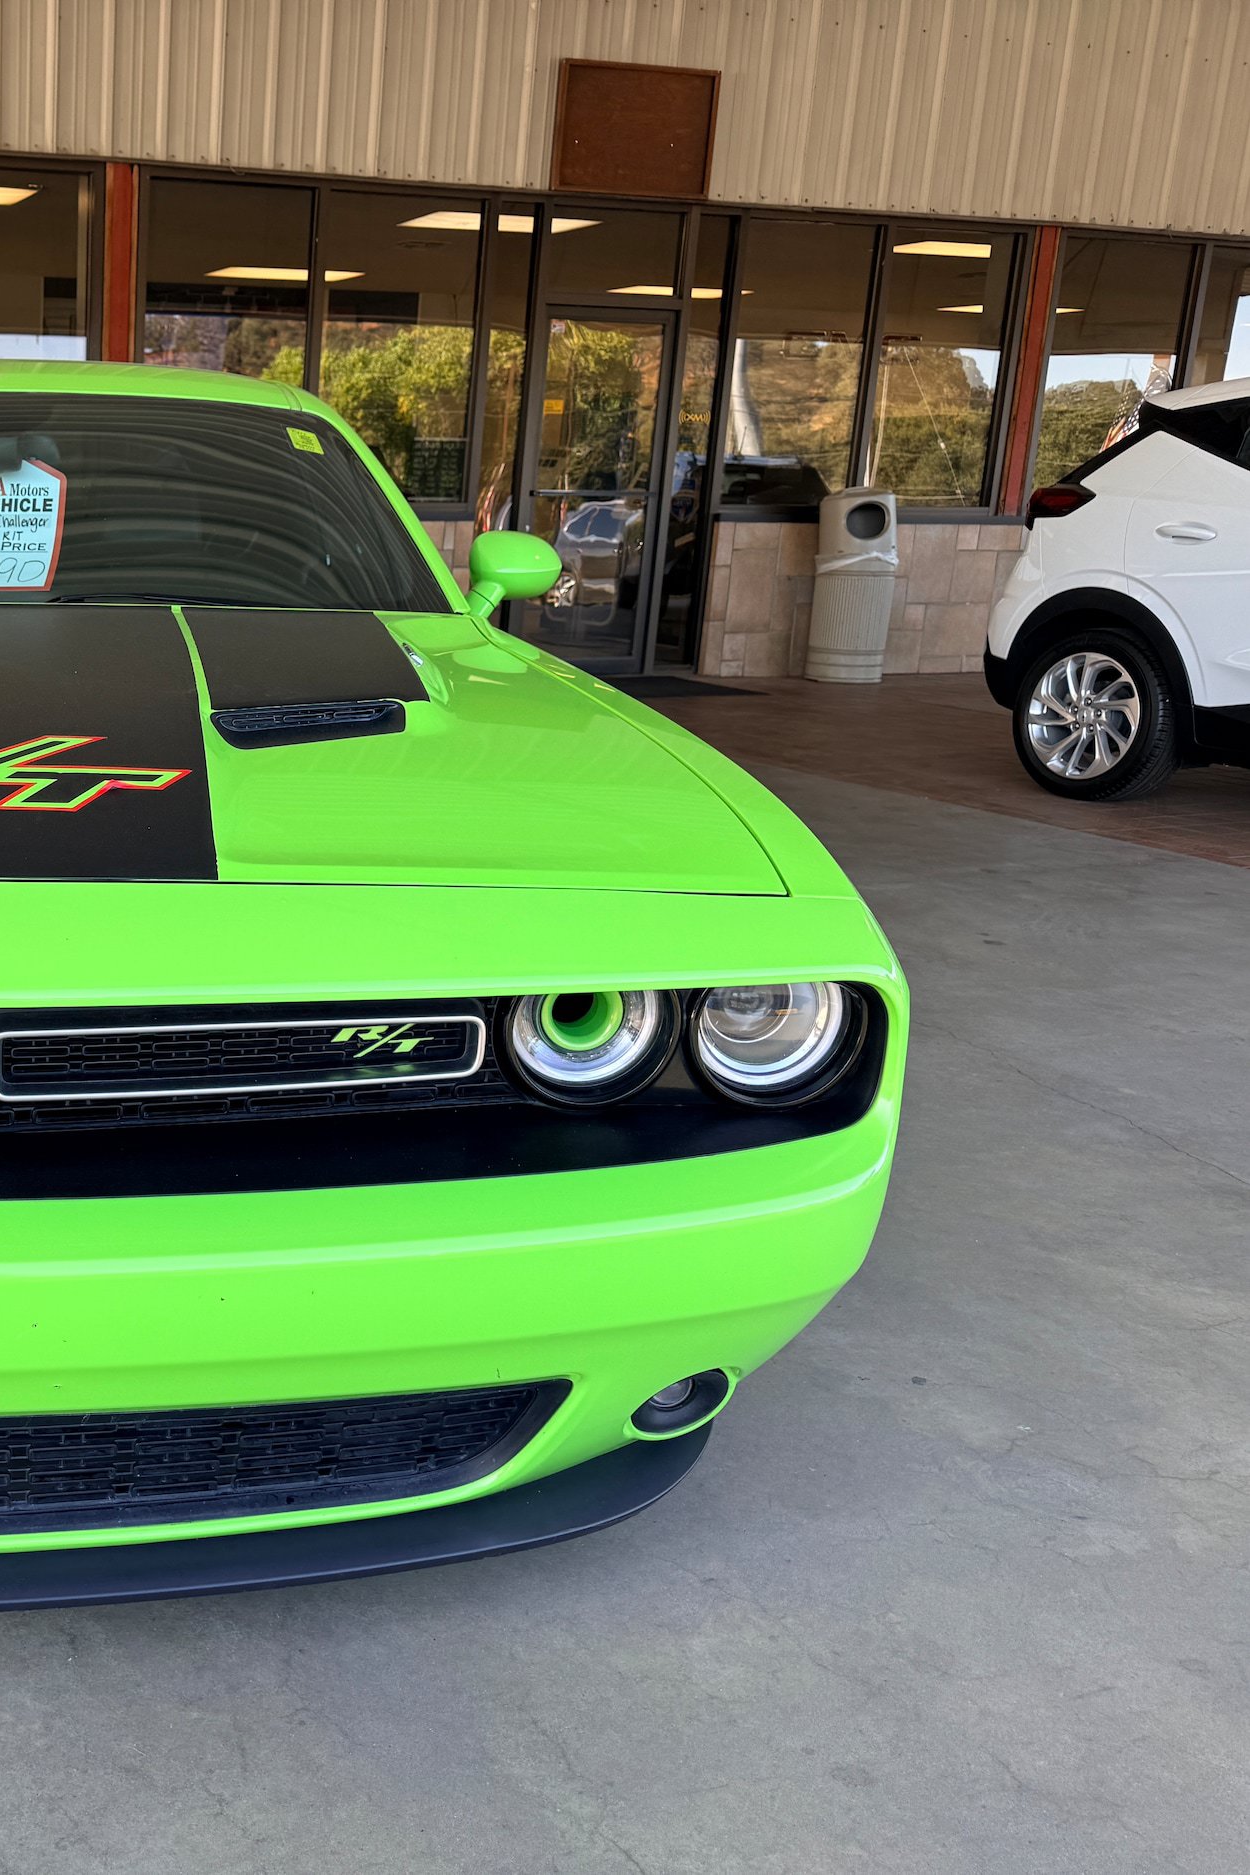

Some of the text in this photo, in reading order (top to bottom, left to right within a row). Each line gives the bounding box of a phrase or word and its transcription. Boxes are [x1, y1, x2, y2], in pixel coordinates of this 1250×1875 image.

[10, 483, 49, 497] Motors
[3, 531, 23, 541] R/T
[1, 541, 47, 551] PRICE
[331, 1023, 435, 1058] R/T
